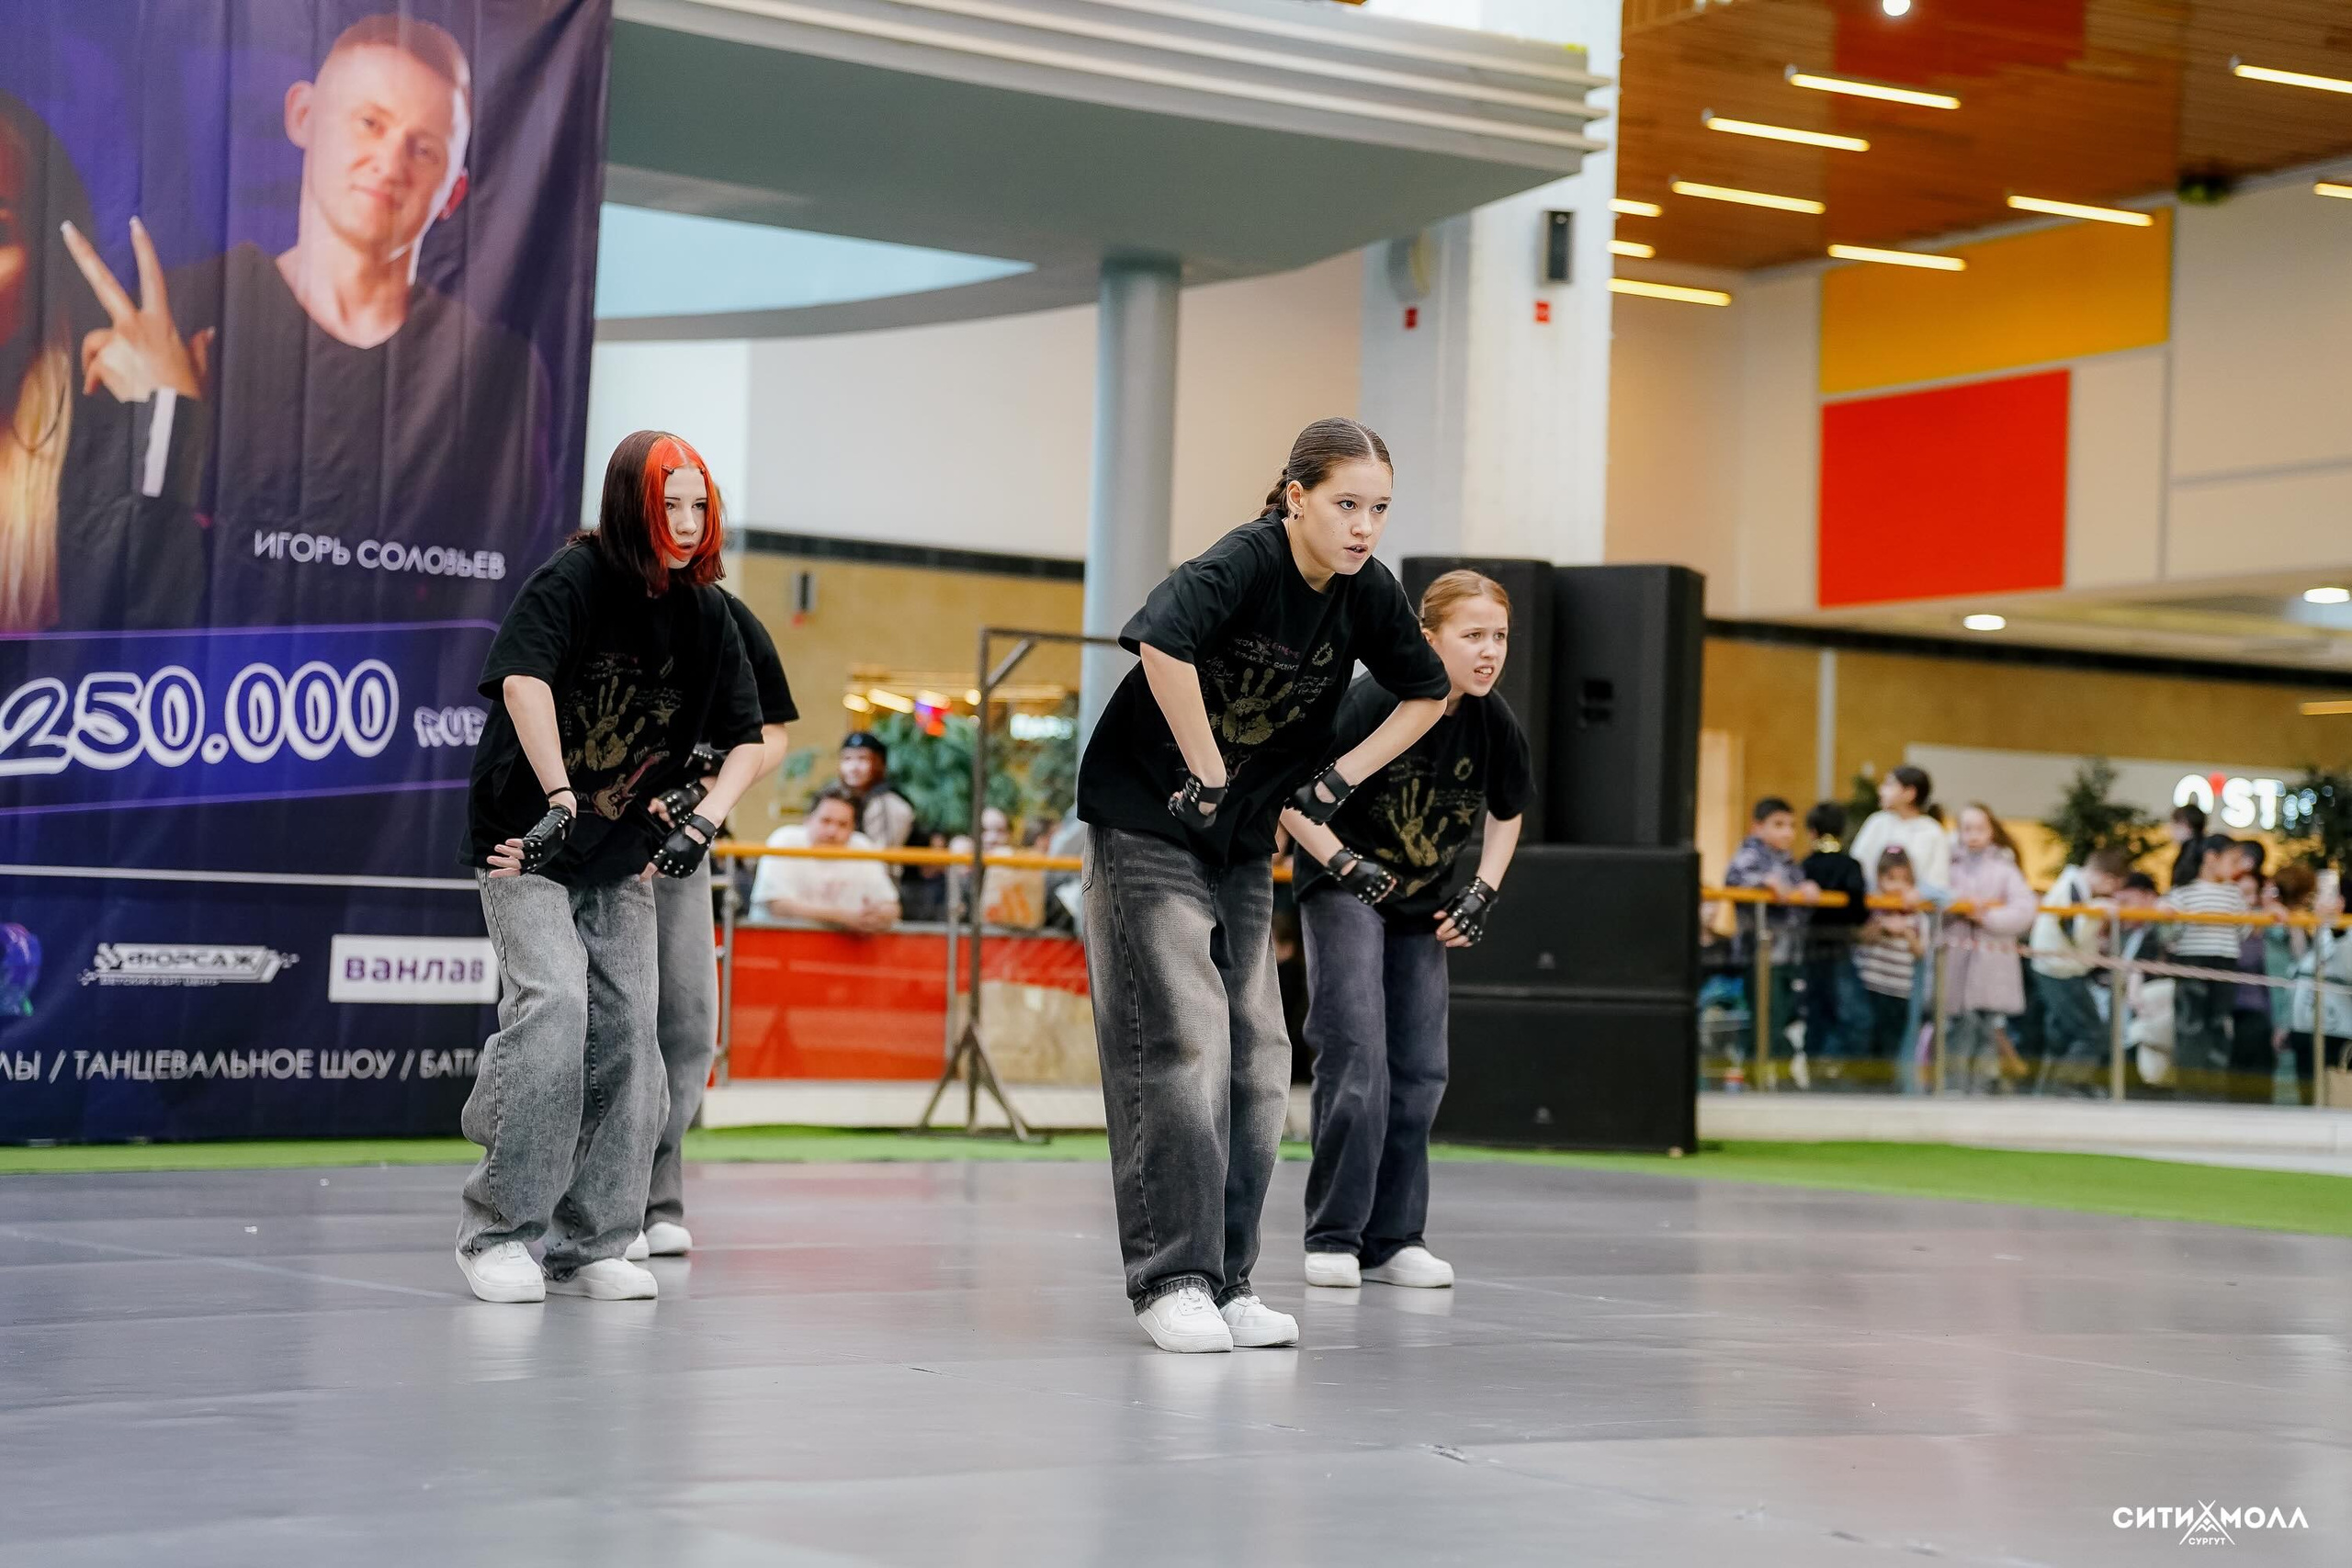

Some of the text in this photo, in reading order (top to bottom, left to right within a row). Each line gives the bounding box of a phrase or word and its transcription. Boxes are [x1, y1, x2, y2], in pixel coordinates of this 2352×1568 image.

[254, 528, 506, 581] ИГОРЬ СОЛОВЬЕВ
[0, 659, 399, 777] 250.000
[74, 1049, 313, 1083] ТАНЦЕВАЛЬНОЕ
[320, 1048, 395, 1079] ШОУ
